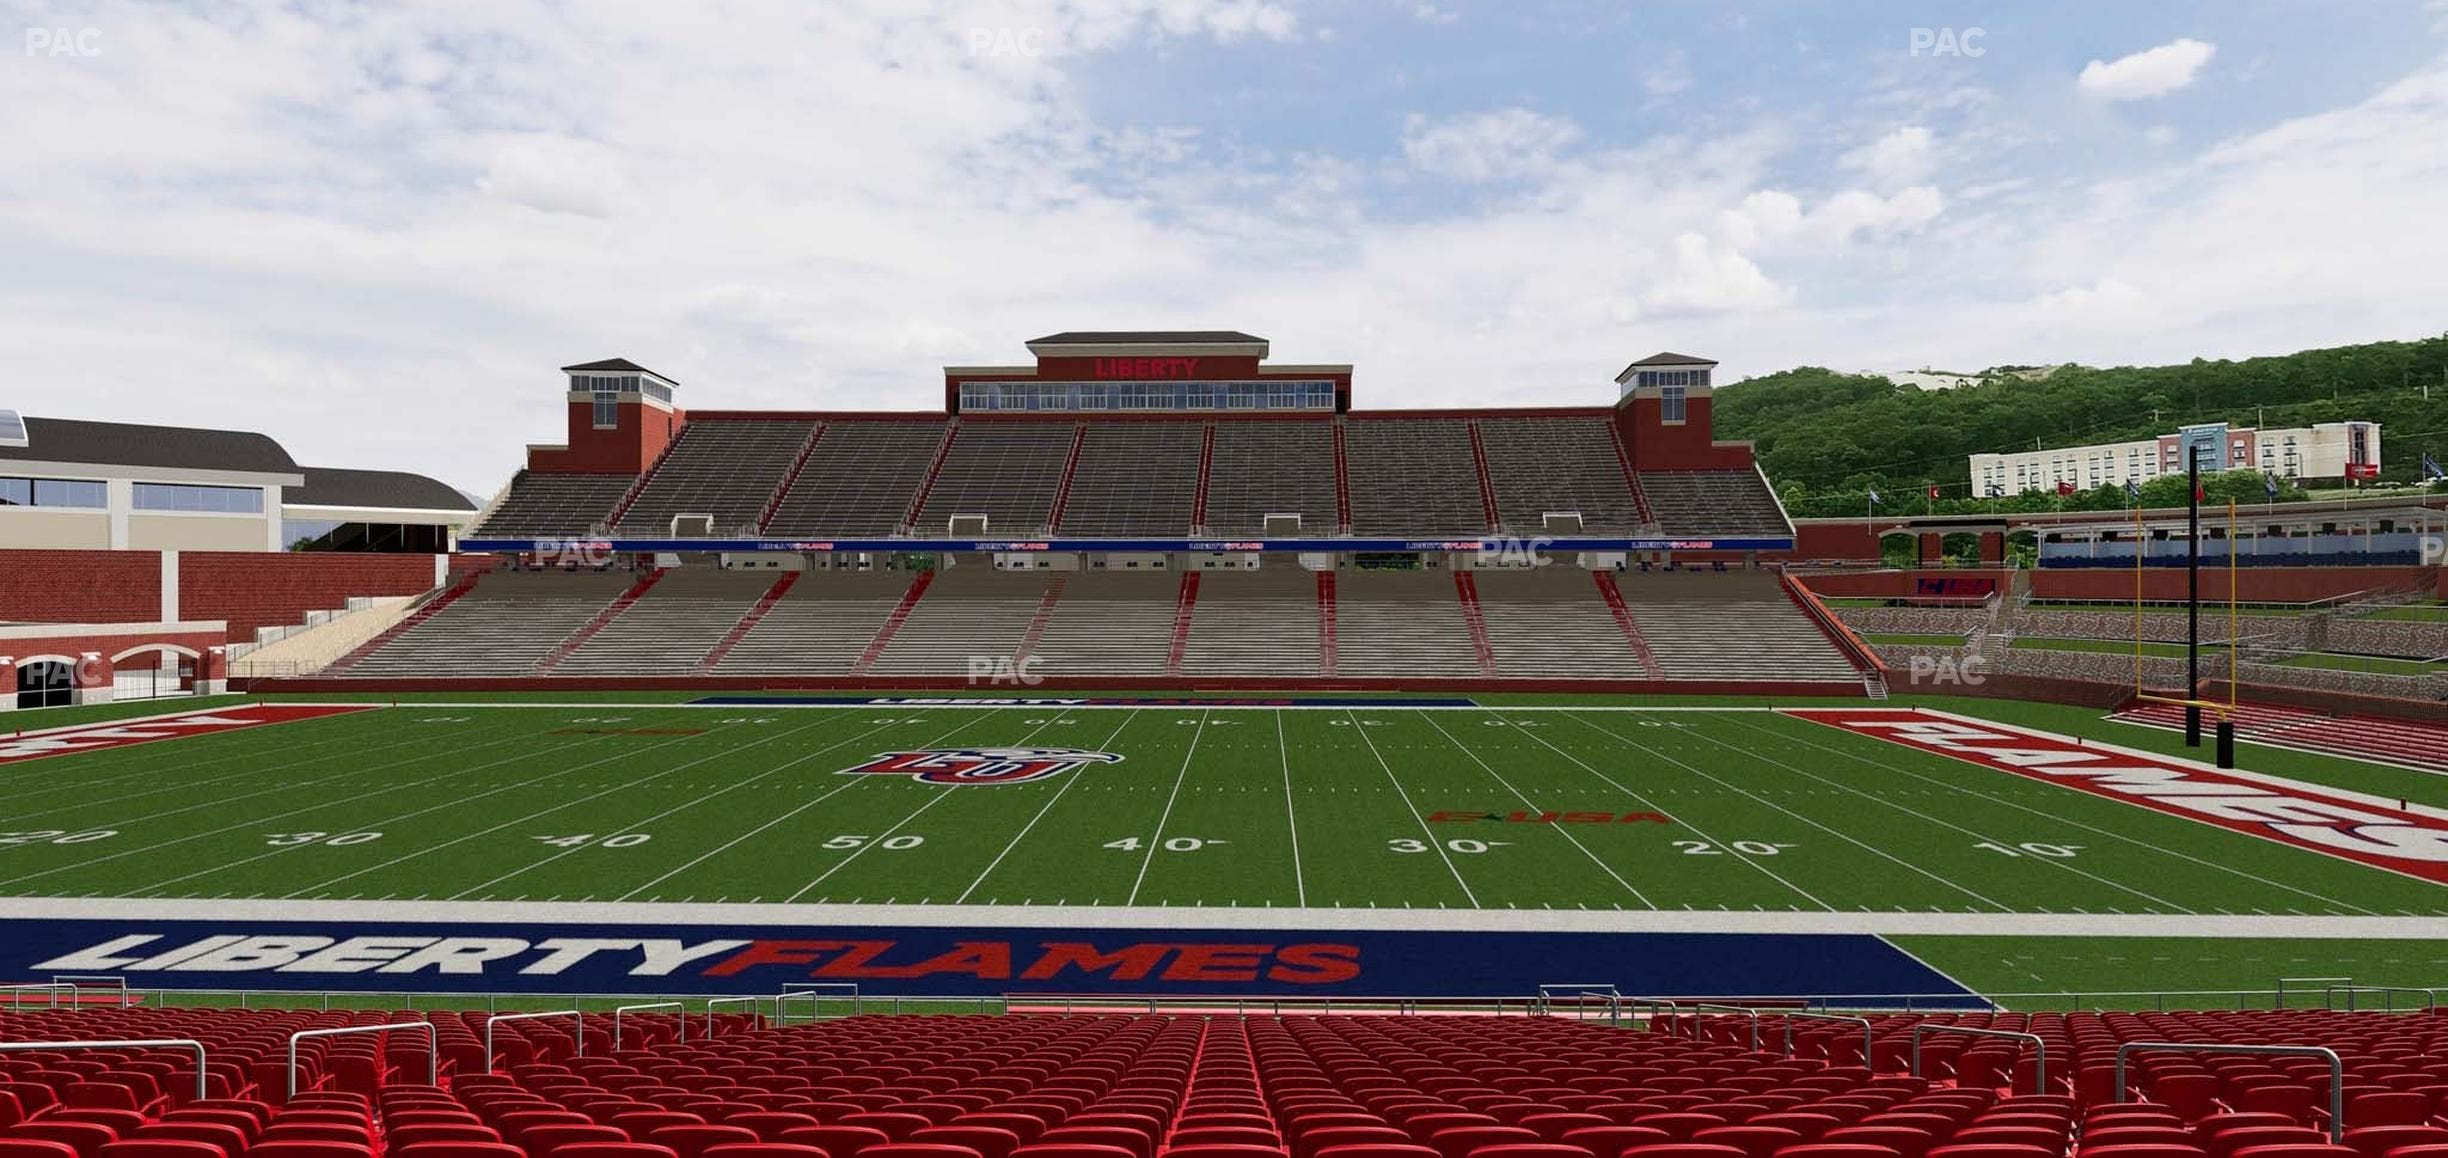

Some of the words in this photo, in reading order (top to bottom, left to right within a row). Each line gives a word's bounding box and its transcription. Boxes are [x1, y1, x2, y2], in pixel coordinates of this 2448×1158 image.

[1095, 358, 1198, 379] LIBERTY
[267, 831, 383, 846] 30
[546, 833, 651, 848] 40
[821, 835, 924, 850] 50
[1102, 837, 1203, 852] 40
[1388, 839, 1490, 854] 30
[1673, 840, 1780, 856] 20
[1973, 842, 2078, 857] 10
